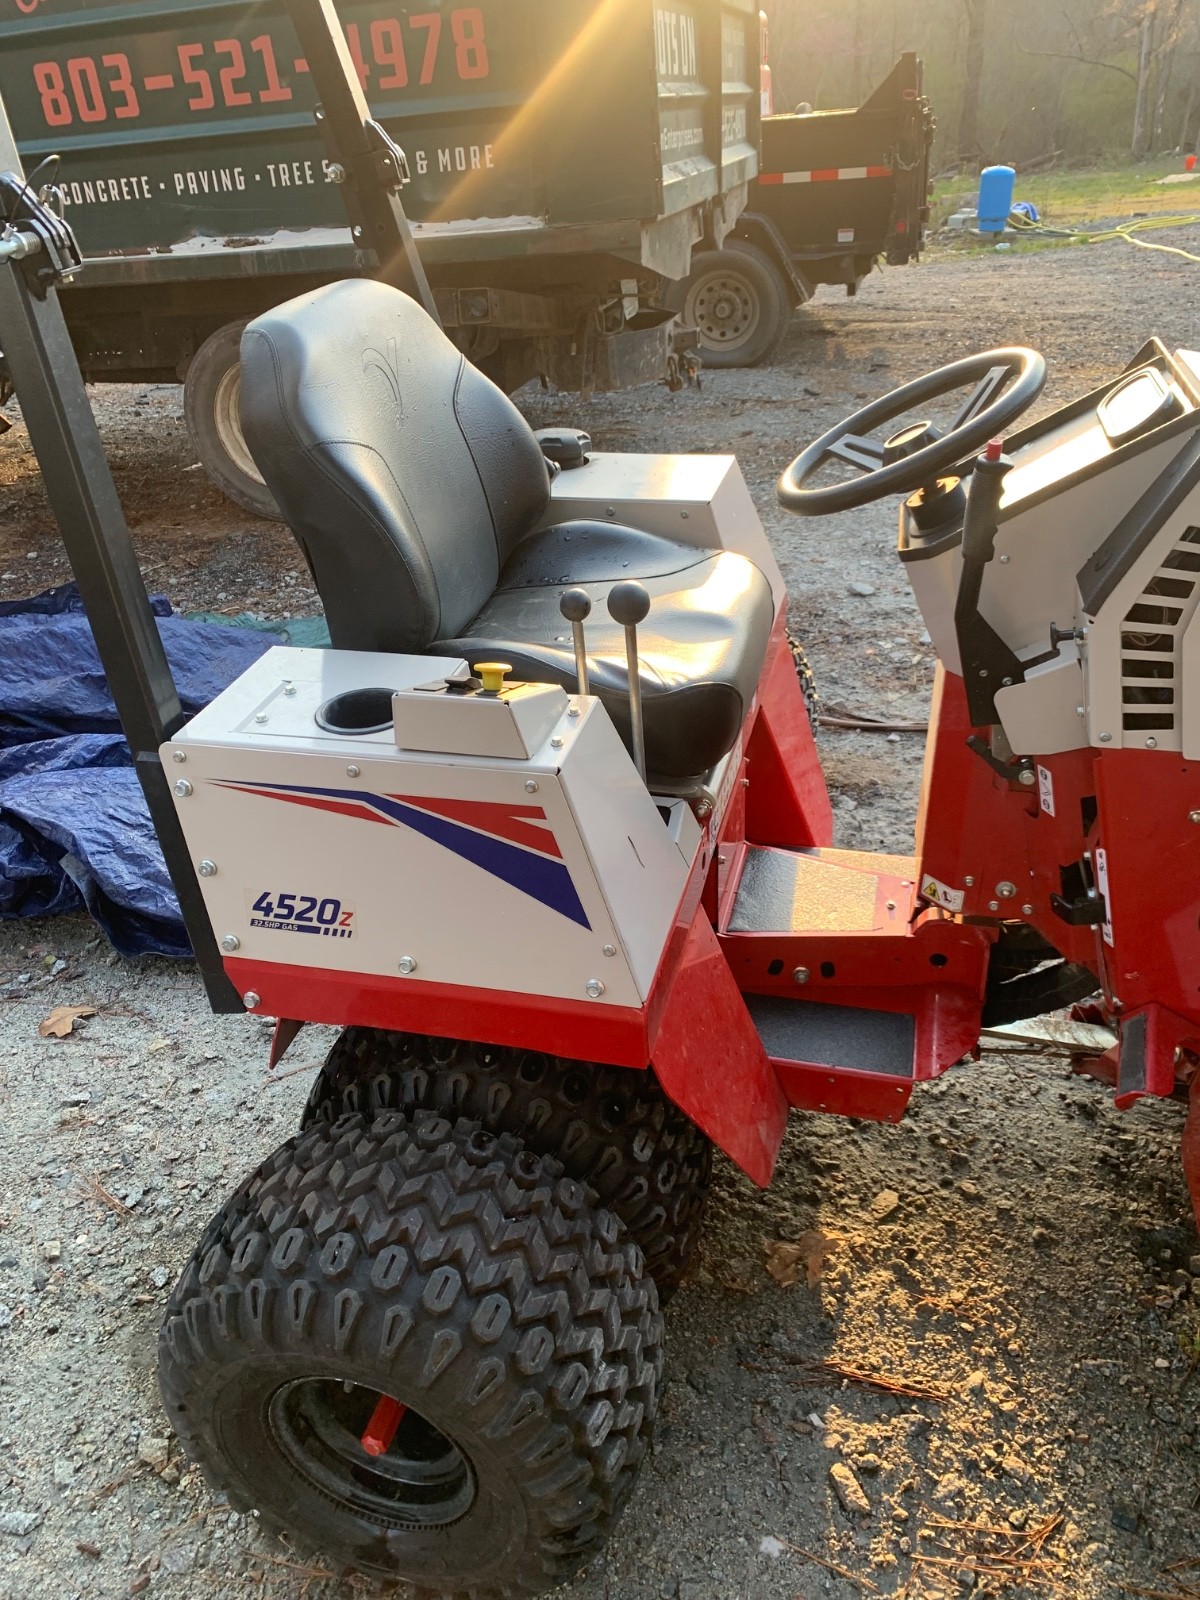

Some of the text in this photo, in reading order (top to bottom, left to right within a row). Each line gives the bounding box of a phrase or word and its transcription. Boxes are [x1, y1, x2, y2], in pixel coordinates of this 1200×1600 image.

[61, 176, 152, 206] CONCRETE
[174, 167, 246, 195] PAVING
[267, 161, 314, 187] TREE
[416, 150, 428, 175] &
[438, 144, 494, 172] MORE
[282, 923, 298, 931] GAS
